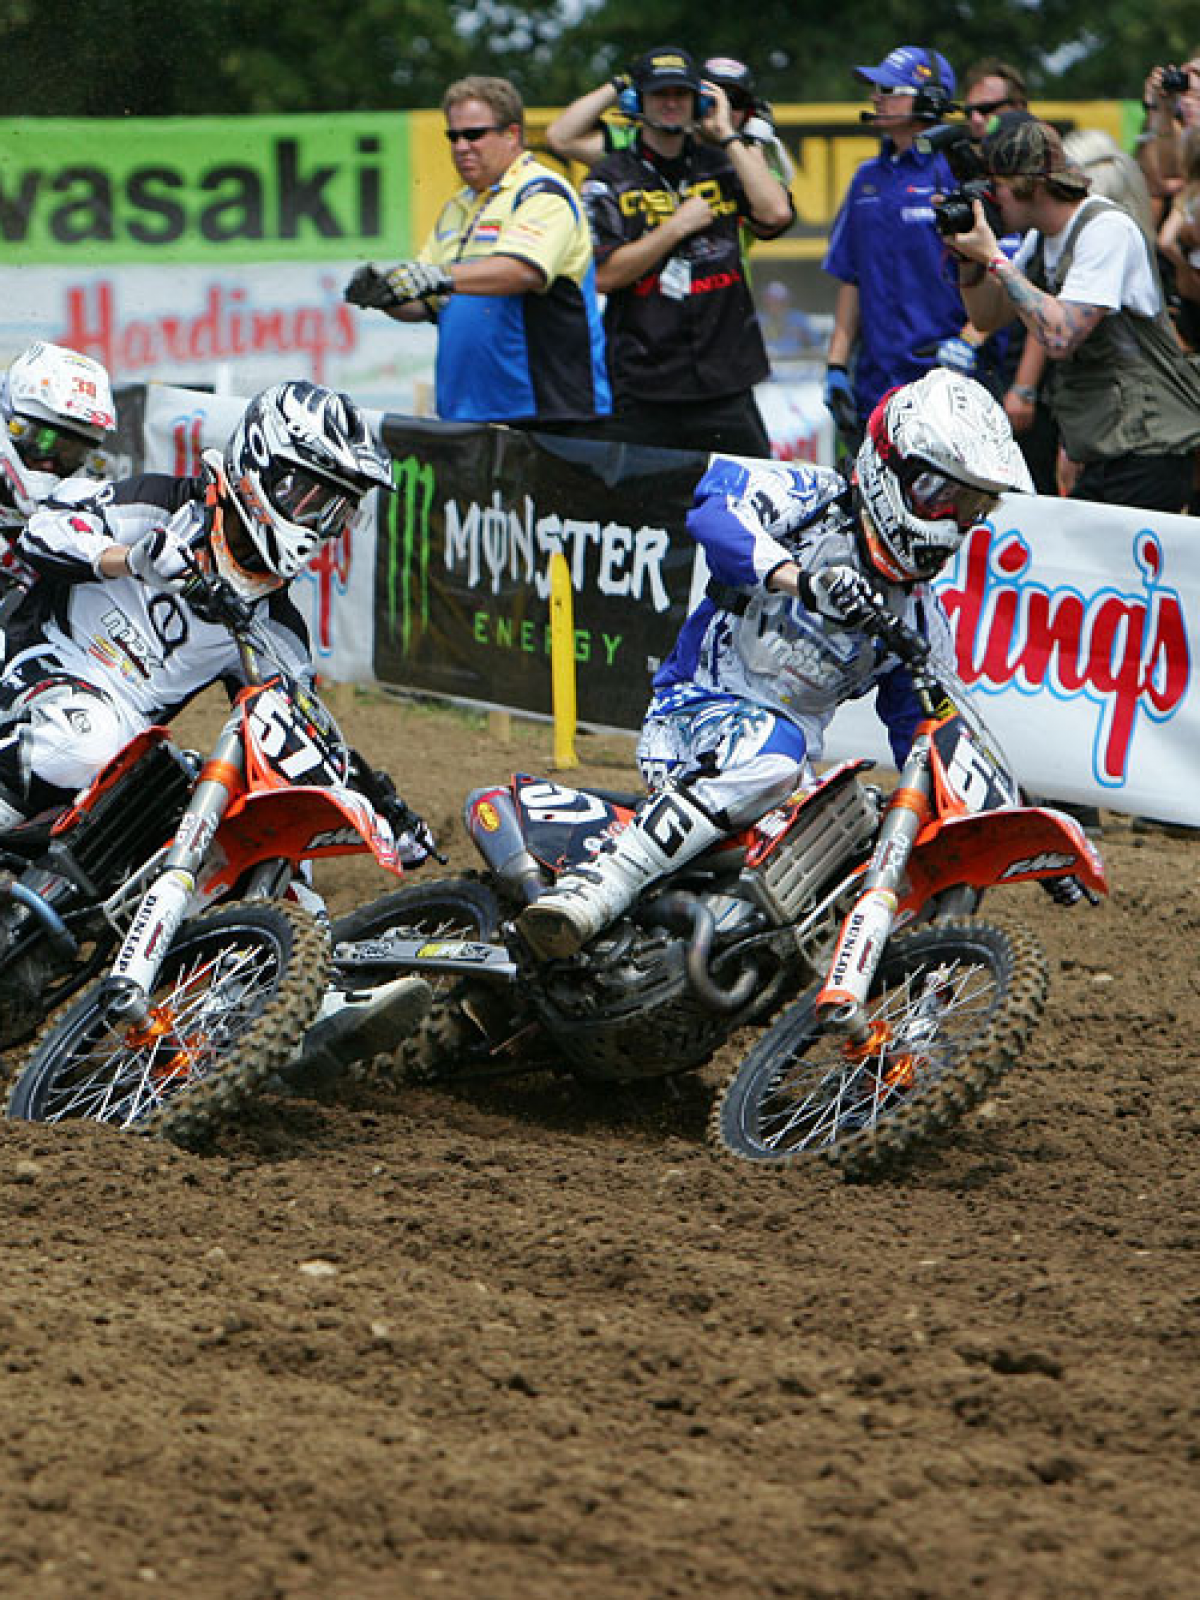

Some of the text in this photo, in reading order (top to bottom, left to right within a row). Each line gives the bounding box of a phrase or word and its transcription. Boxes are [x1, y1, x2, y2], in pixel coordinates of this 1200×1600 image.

[57, 277, 358, 386] Harding's
[442, 490, 670, 613] MONSTER
[937, 524, 1191, 782] ding's
[249, 690, 343, 784] 57
[117, 894, 158, 973] DUNLOP
[830, 913, 866, 986] DUNLOP
